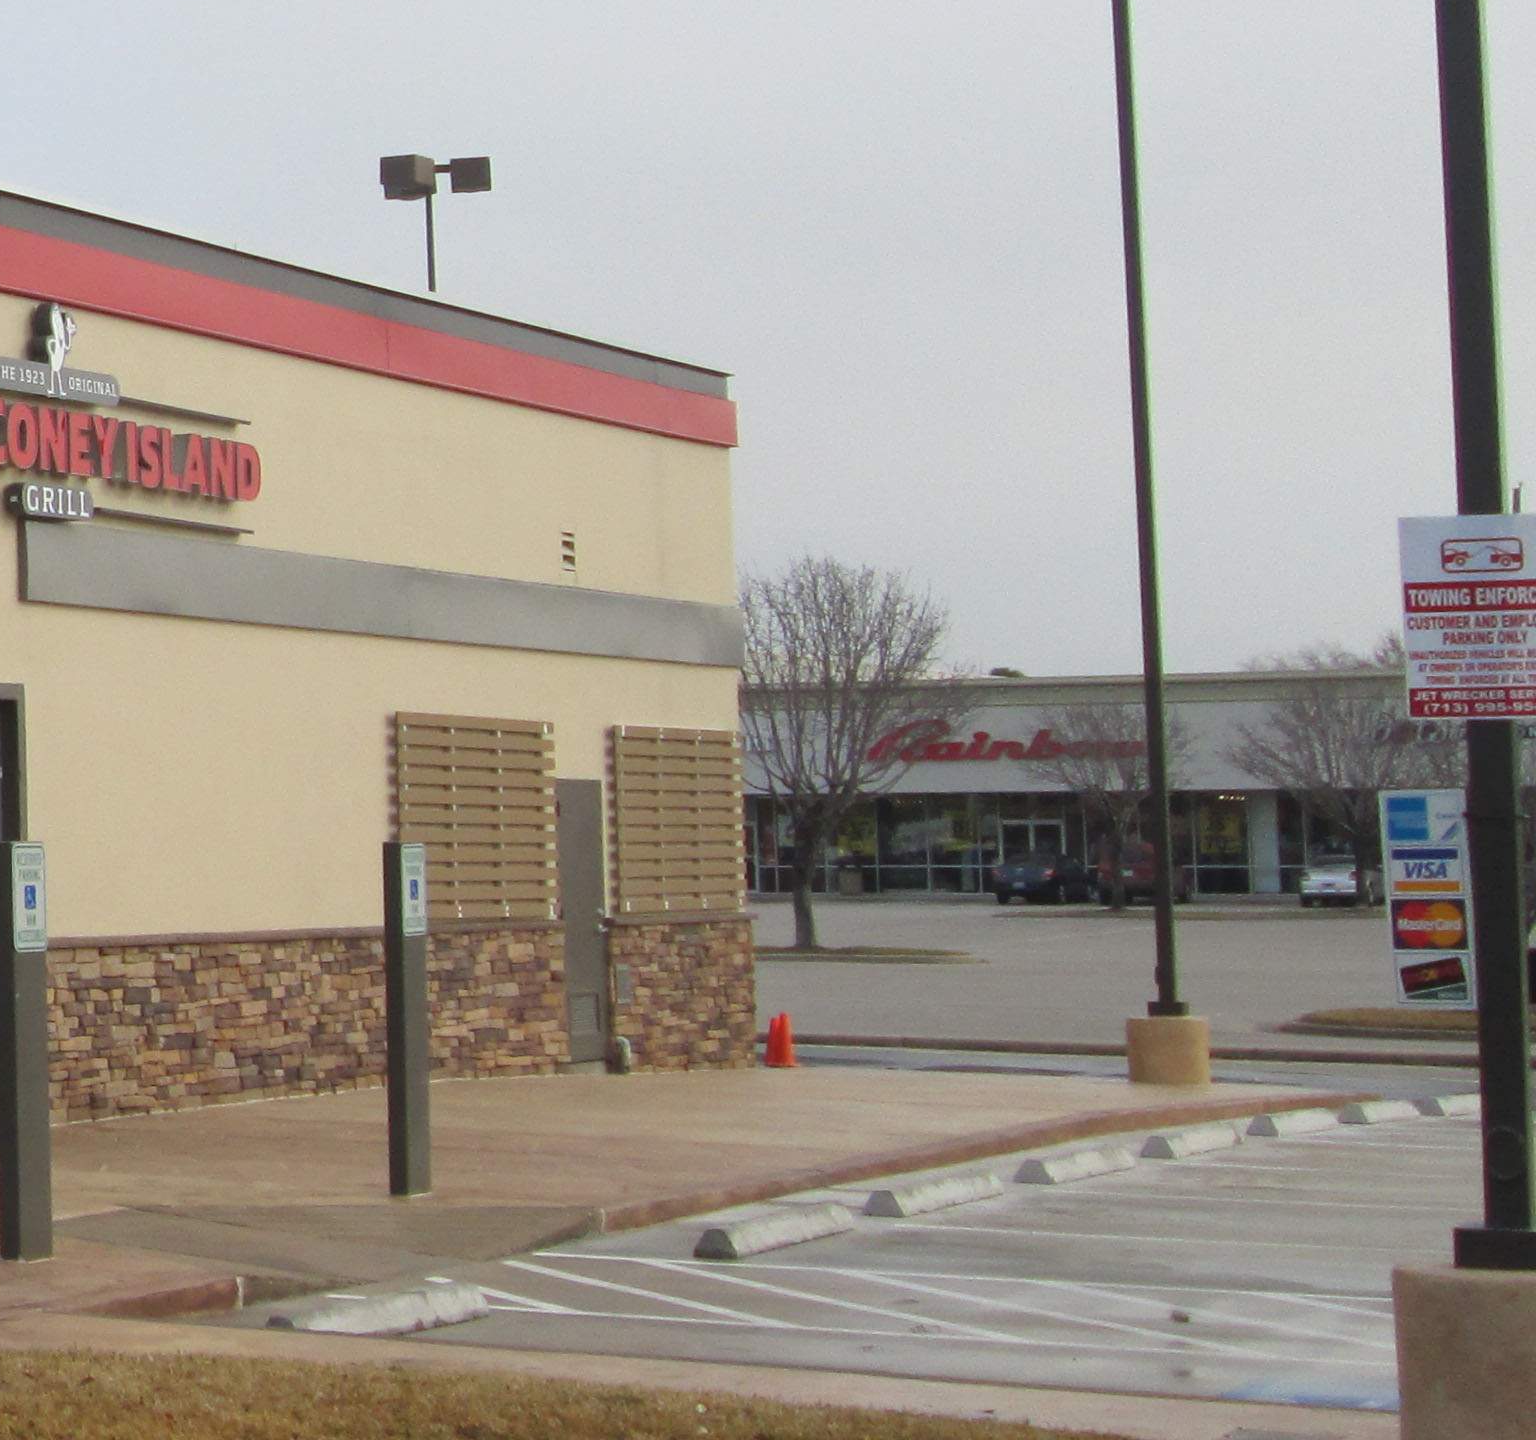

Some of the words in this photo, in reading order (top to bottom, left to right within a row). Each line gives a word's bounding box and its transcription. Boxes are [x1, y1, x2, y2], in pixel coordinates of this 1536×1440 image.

[19, 368, 45, 385] 1923
[68, 376, 117, 397] ORIGINAL
[127, 420, 262, 502] ISLAND
[27, 484, 90, 518] GRILL
[1408, 588, 1471, 607] TOWING
[1407, 615, 1470, 630] CUSTOMER
[1475, 614, 1498, 628] AND
[1442, 631, 1495, 645] PARKING
[1498, 630, 1528, 644] ONLY
[1415, 691, 1437, 701] JET
[1441, 690, 1505, 700] WRECKER
[1424, 702, 1468, 714] (713)
[1403, 861, 1448, 879] VISA
[1397, 918, 1463, 931] MasterCard
